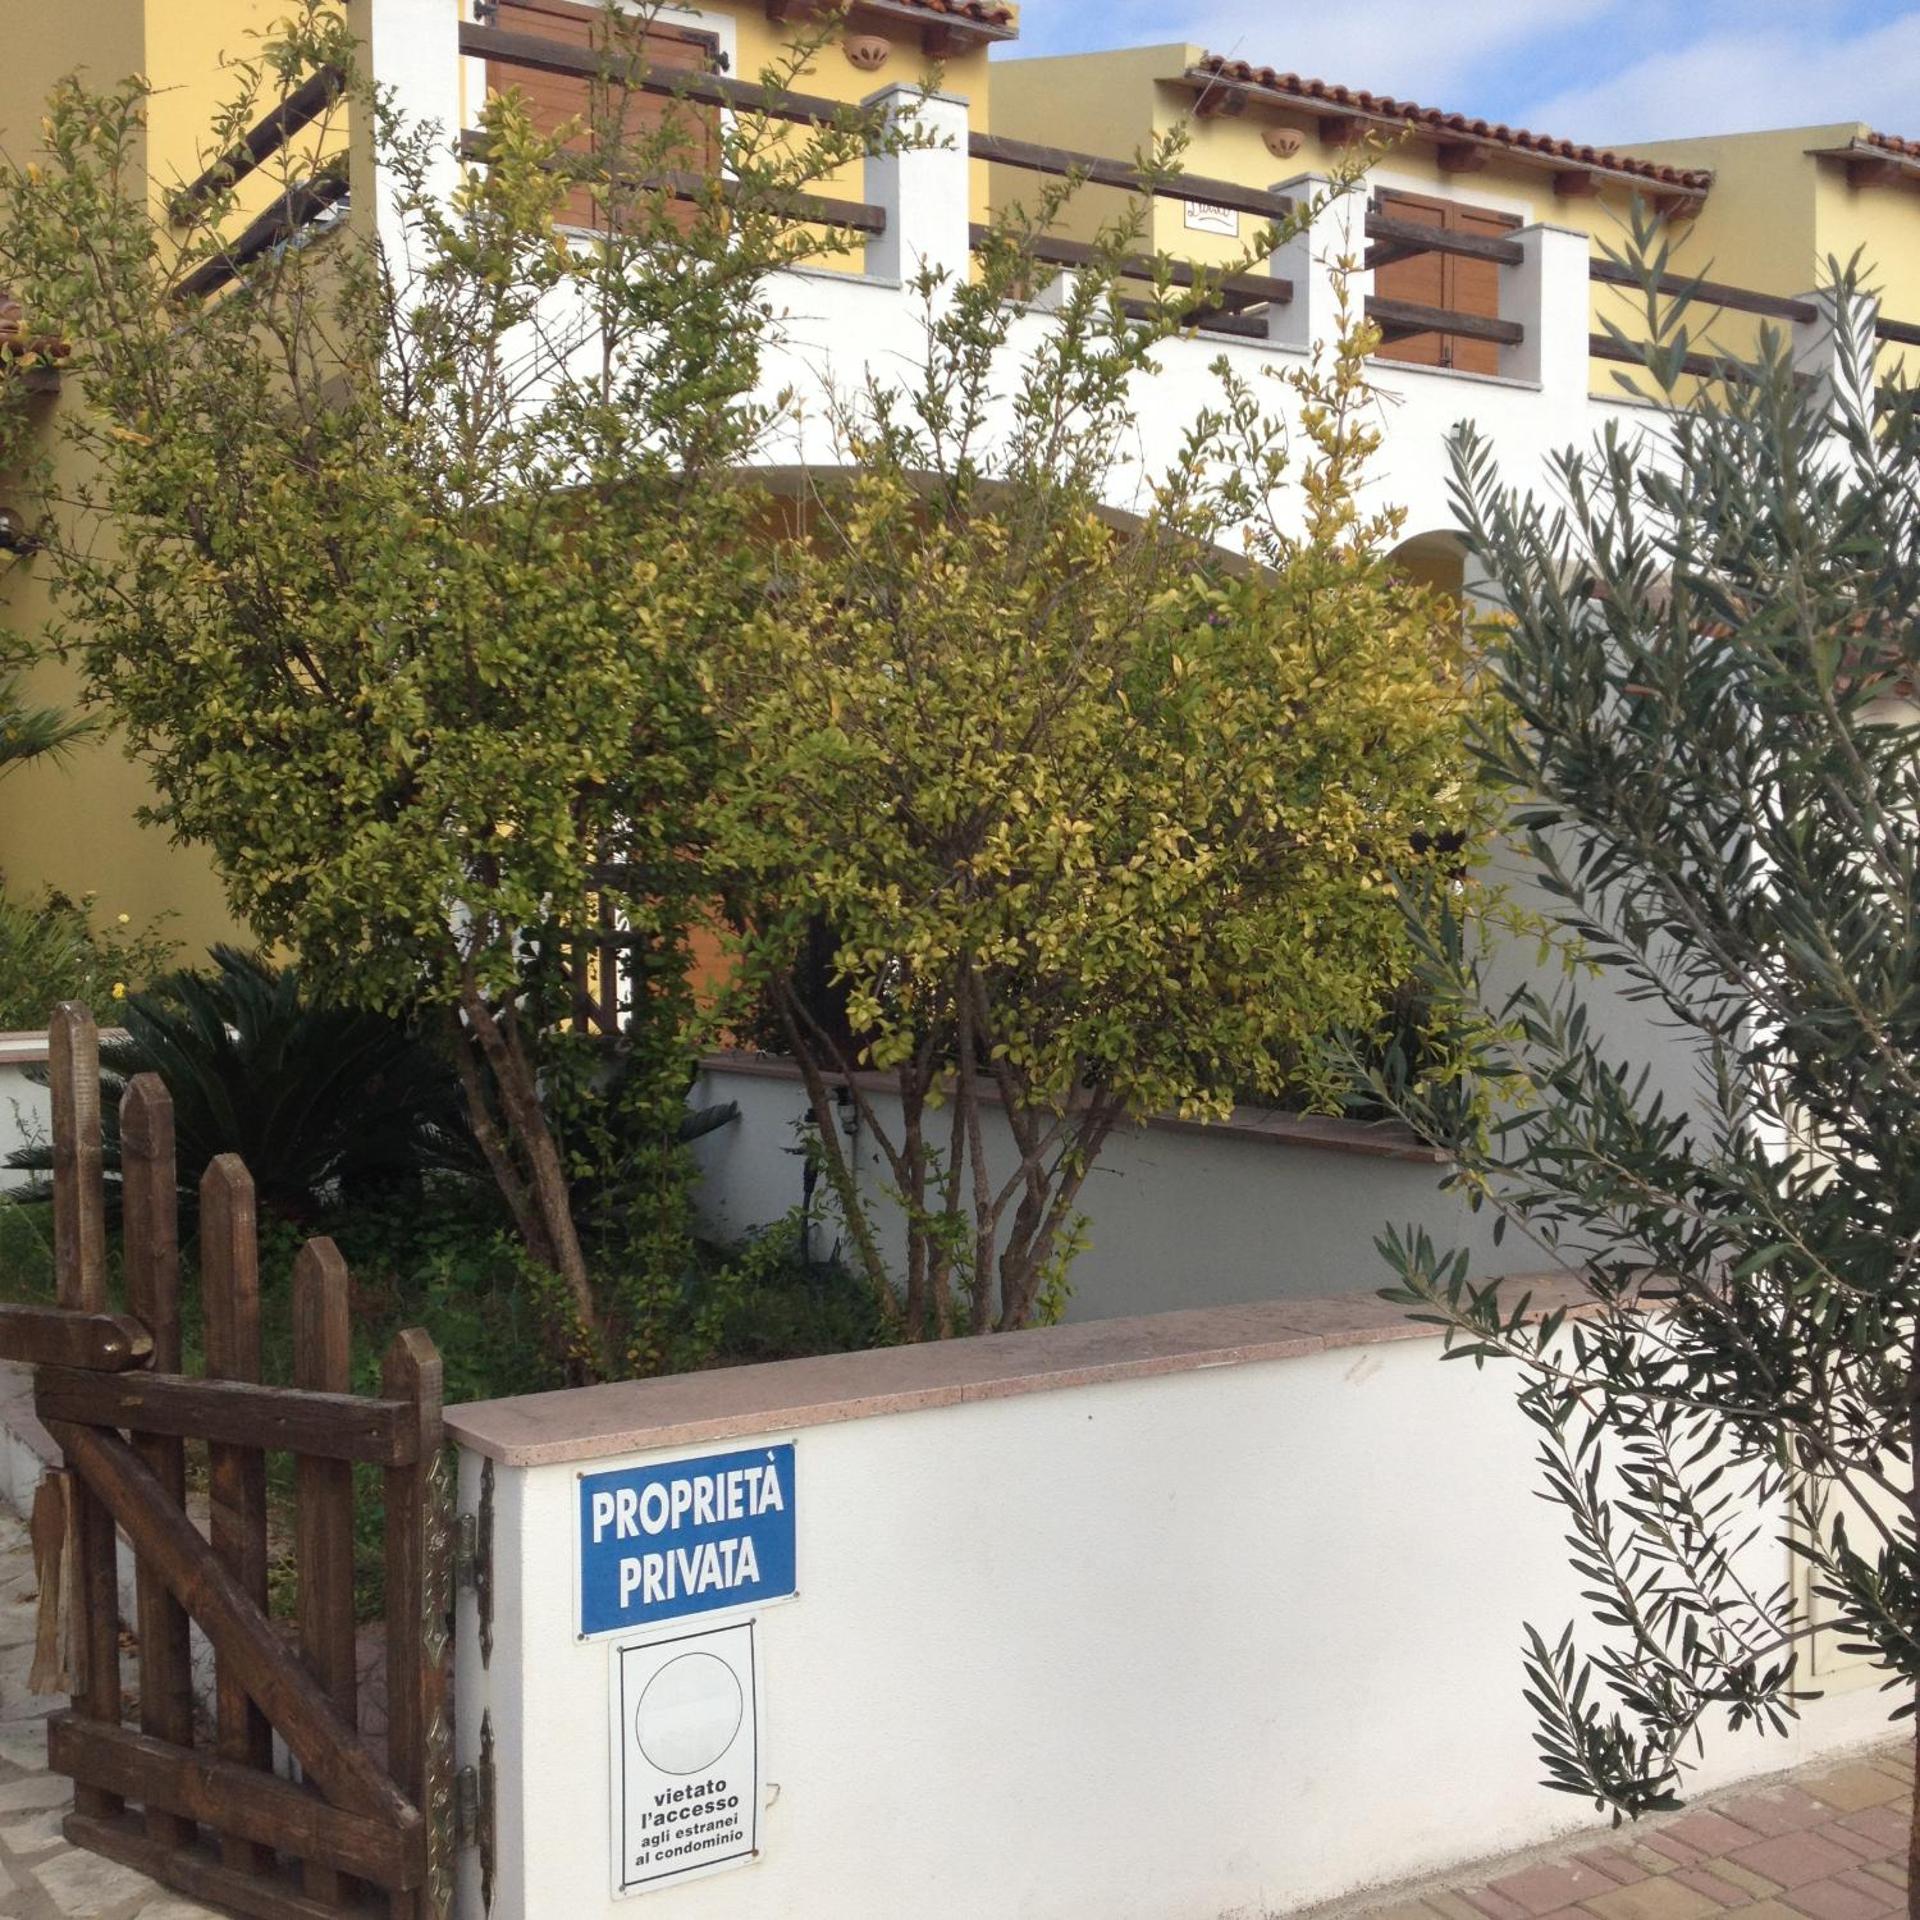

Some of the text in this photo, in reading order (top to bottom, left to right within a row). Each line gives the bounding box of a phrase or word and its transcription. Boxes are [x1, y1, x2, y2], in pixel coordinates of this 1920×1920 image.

[592, 1451, 784, 1543] PROPRIETÀ
[620, 1535, 760, 1608] PRIVATA
[654, 1779, 727, 1806] vietato
[641, 1795, 739, 1829] l'accesso
[641, 1812, 738, 1848] agli estranei
[635, 1830, 743, 1866] al condominio
